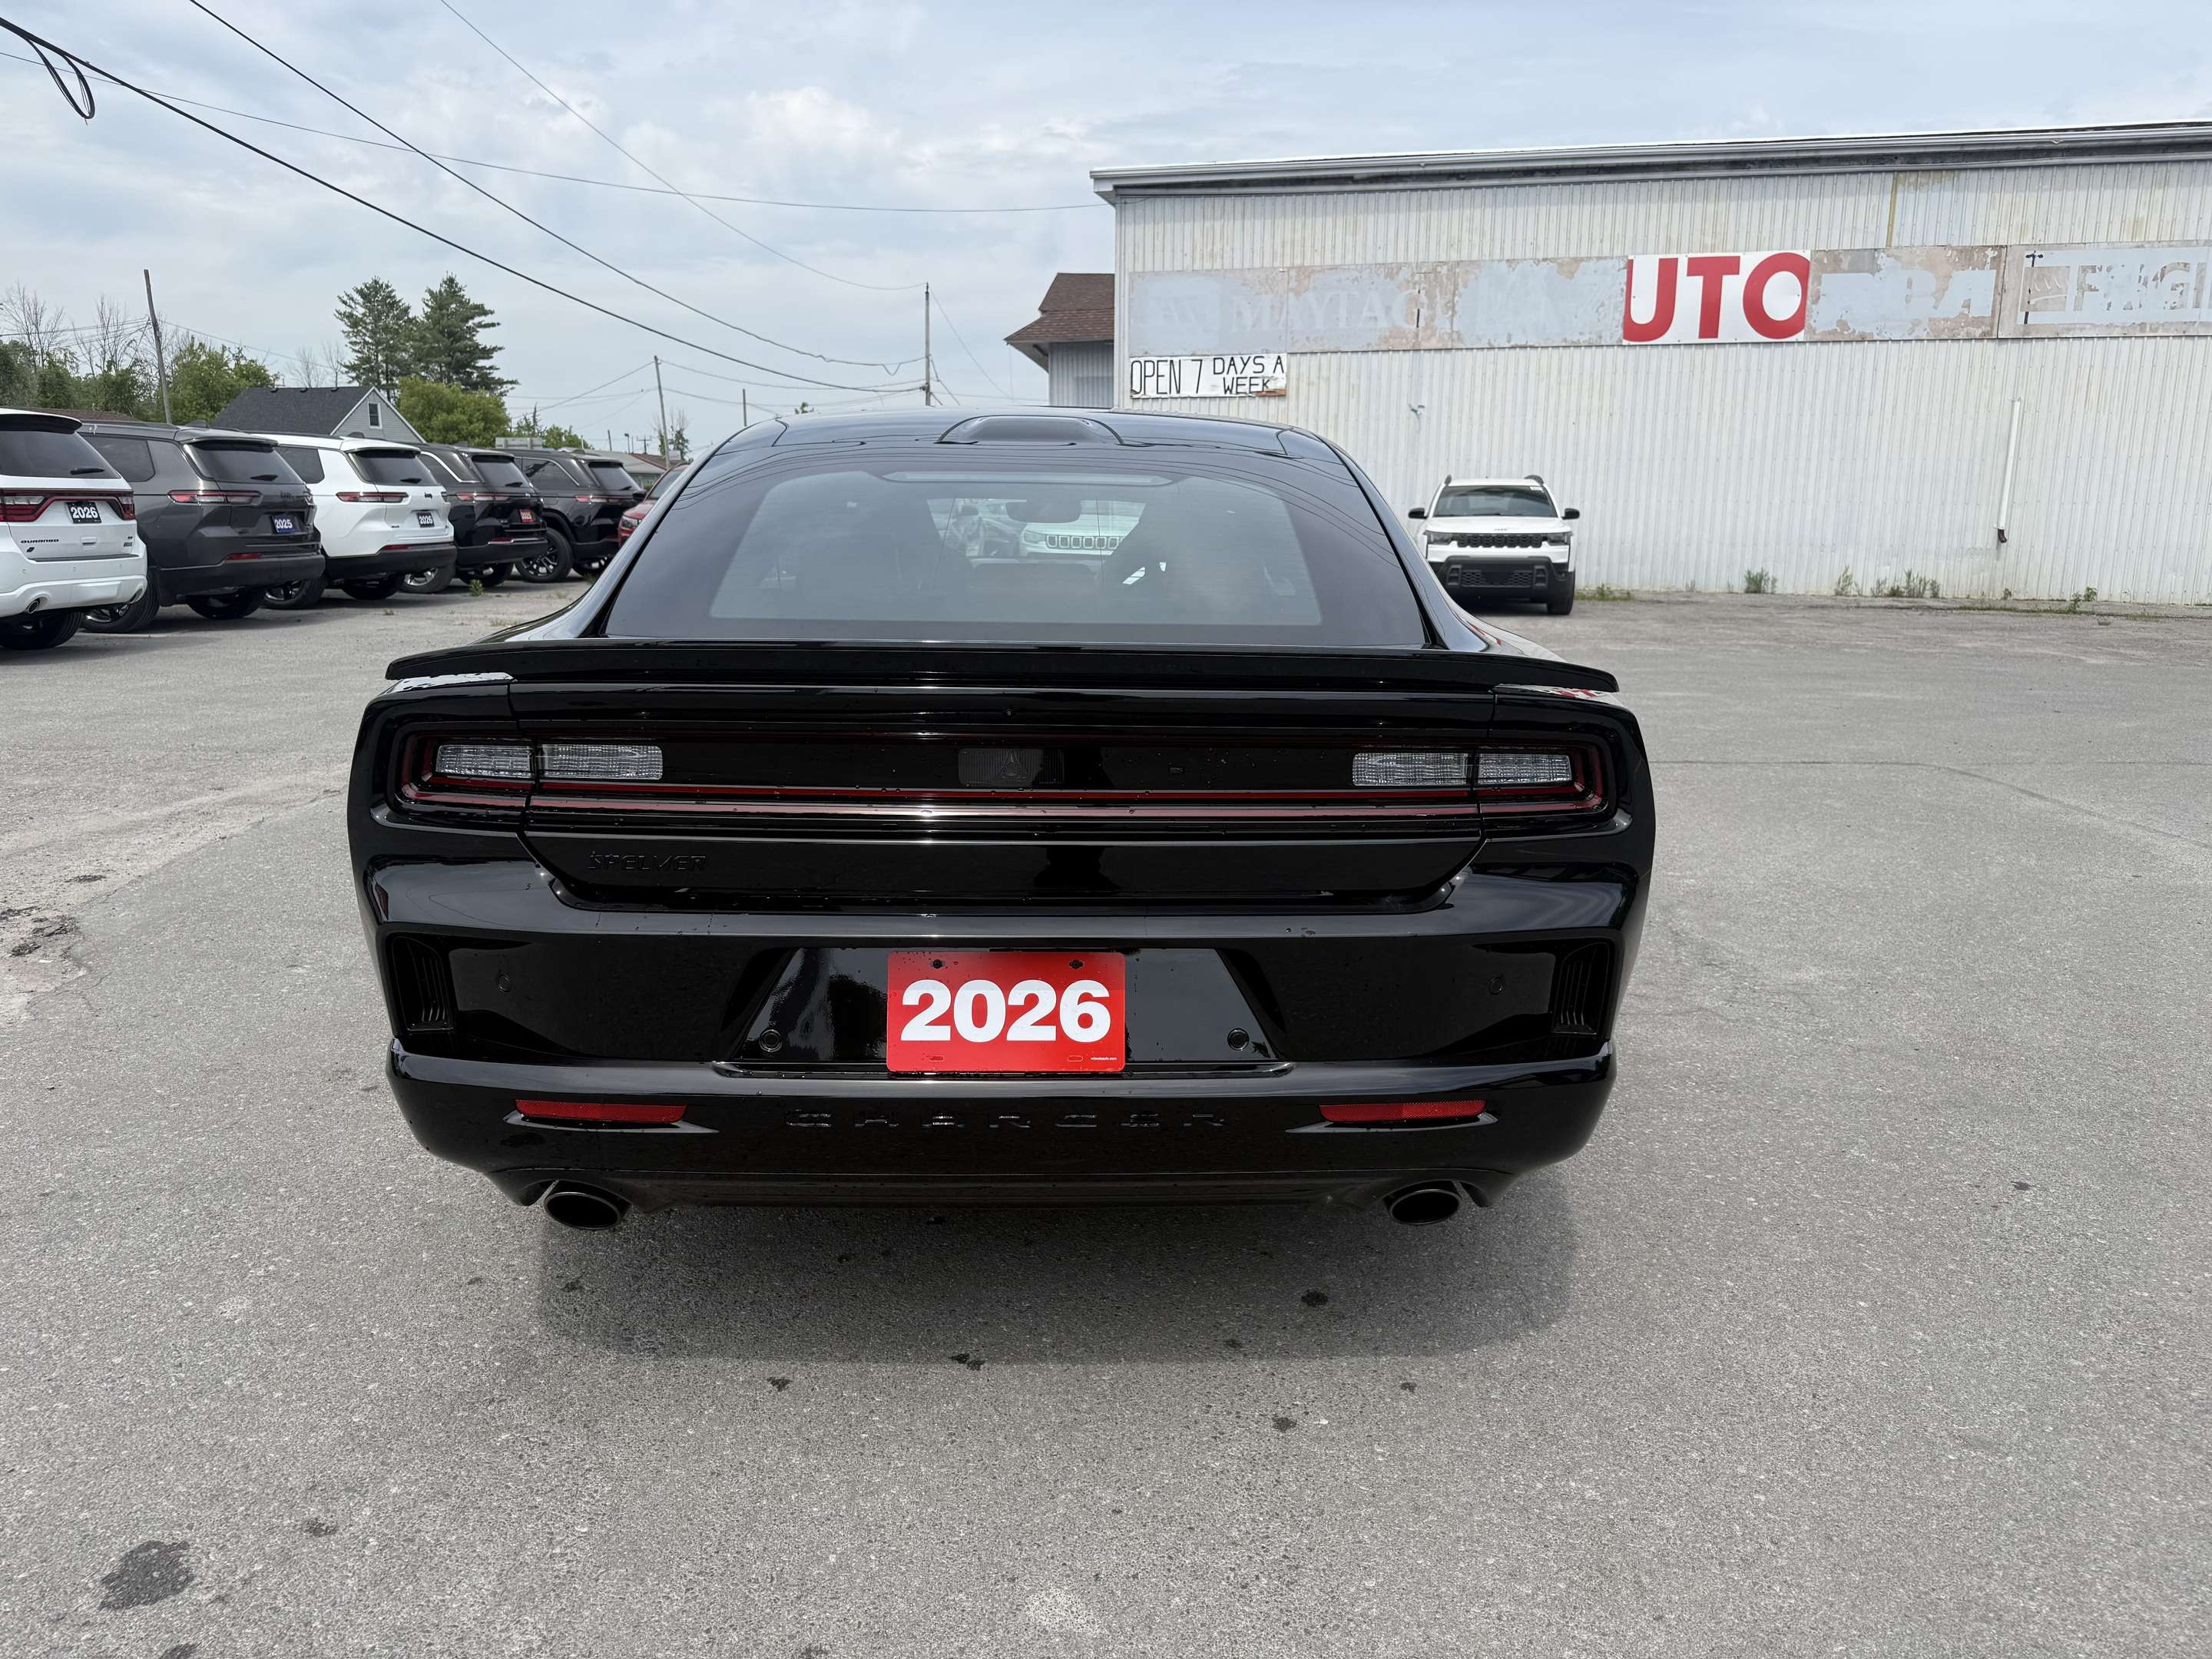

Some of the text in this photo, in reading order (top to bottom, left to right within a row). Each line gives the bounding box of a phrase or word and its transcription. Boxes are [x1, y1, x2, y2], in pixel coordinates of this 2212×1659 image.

[1622, 252, 1810, 342] UTO
[1131, 355, 1285, 395] OPEN 7 DAYS A
[1223, 376, 1270, 395] WEEK
[70, 506, 98, 518] 2026
[274, 518, 293, 529] 2025
[900, 979, 1111, 1043] 2026
